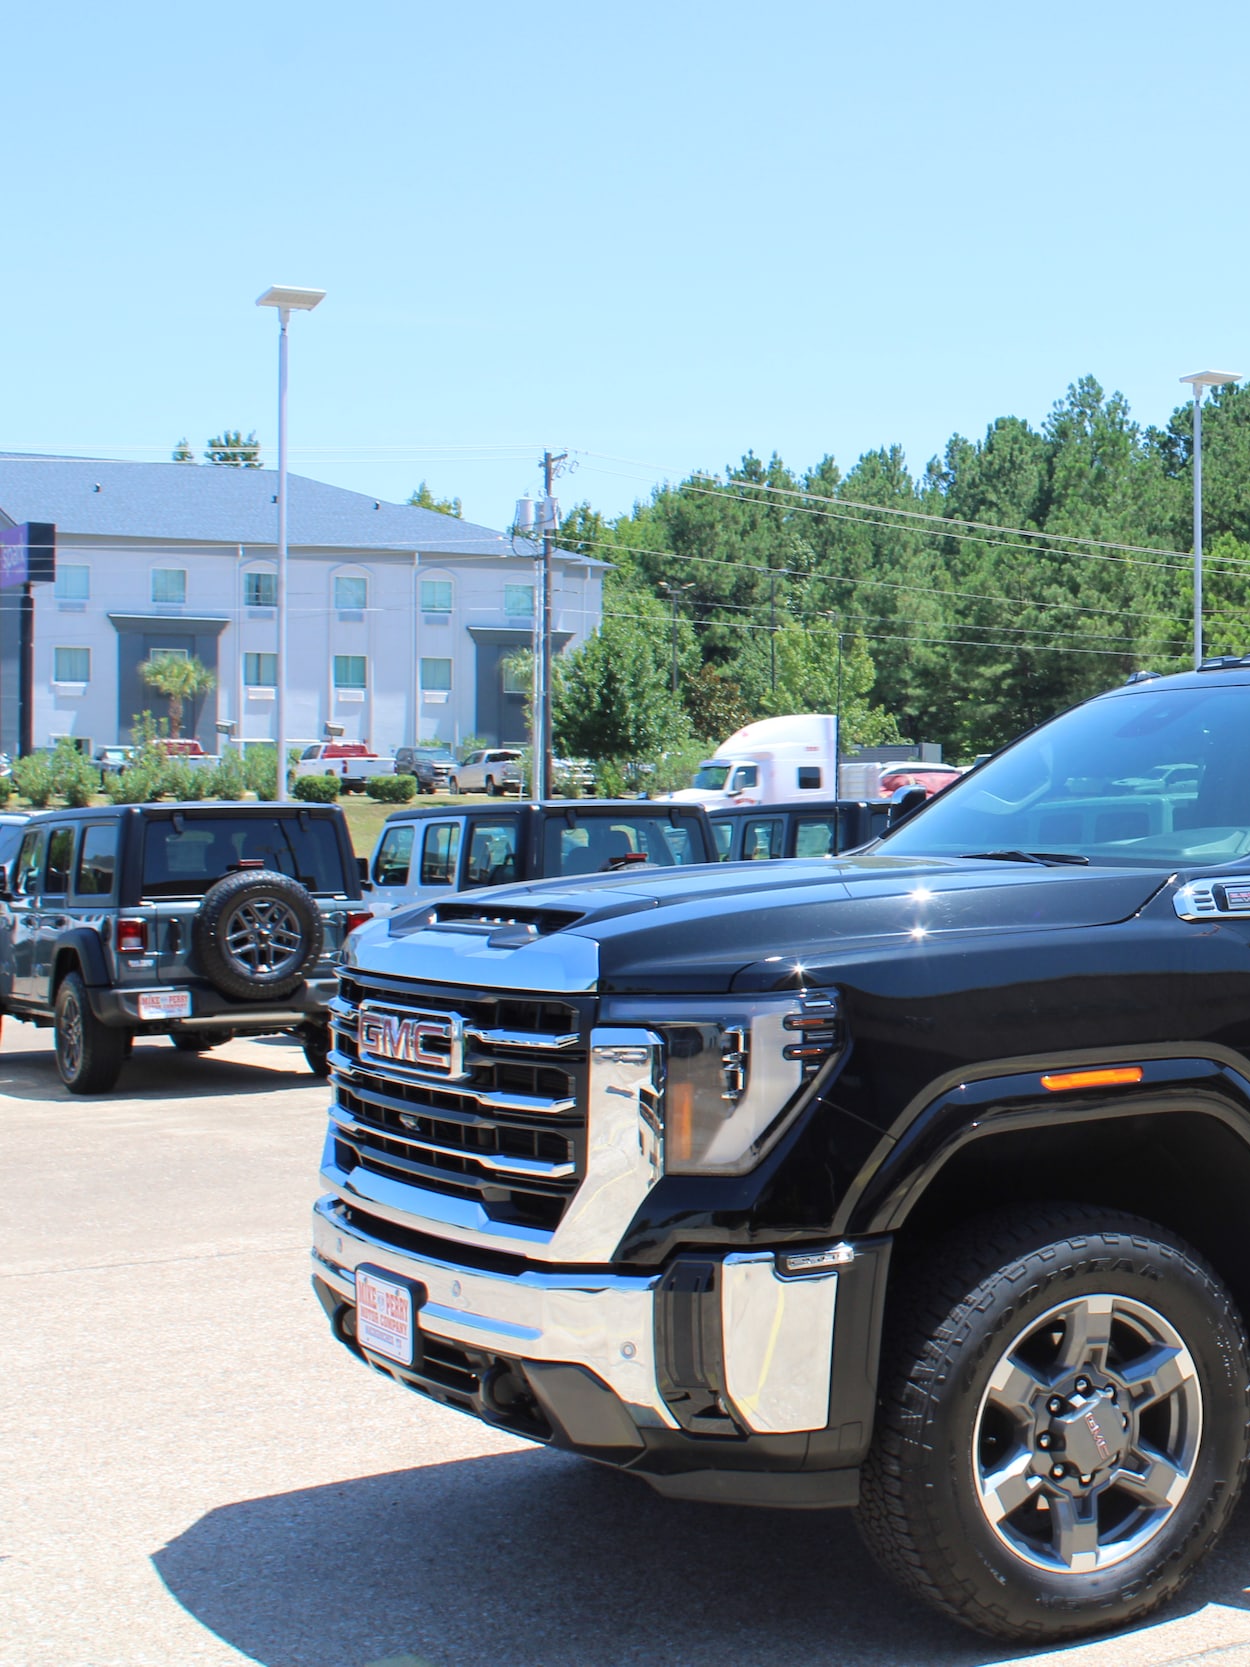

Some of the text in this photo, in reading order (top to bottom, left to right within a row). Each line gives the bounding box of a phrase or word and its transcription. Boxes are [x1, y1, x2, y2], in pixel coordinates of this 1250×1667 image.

[360, 1010, 451, 1068] GMC
[359, 1281, 408, 1323] MIKE PERRY
[379, 1313, 408, 1336] COMPANY
